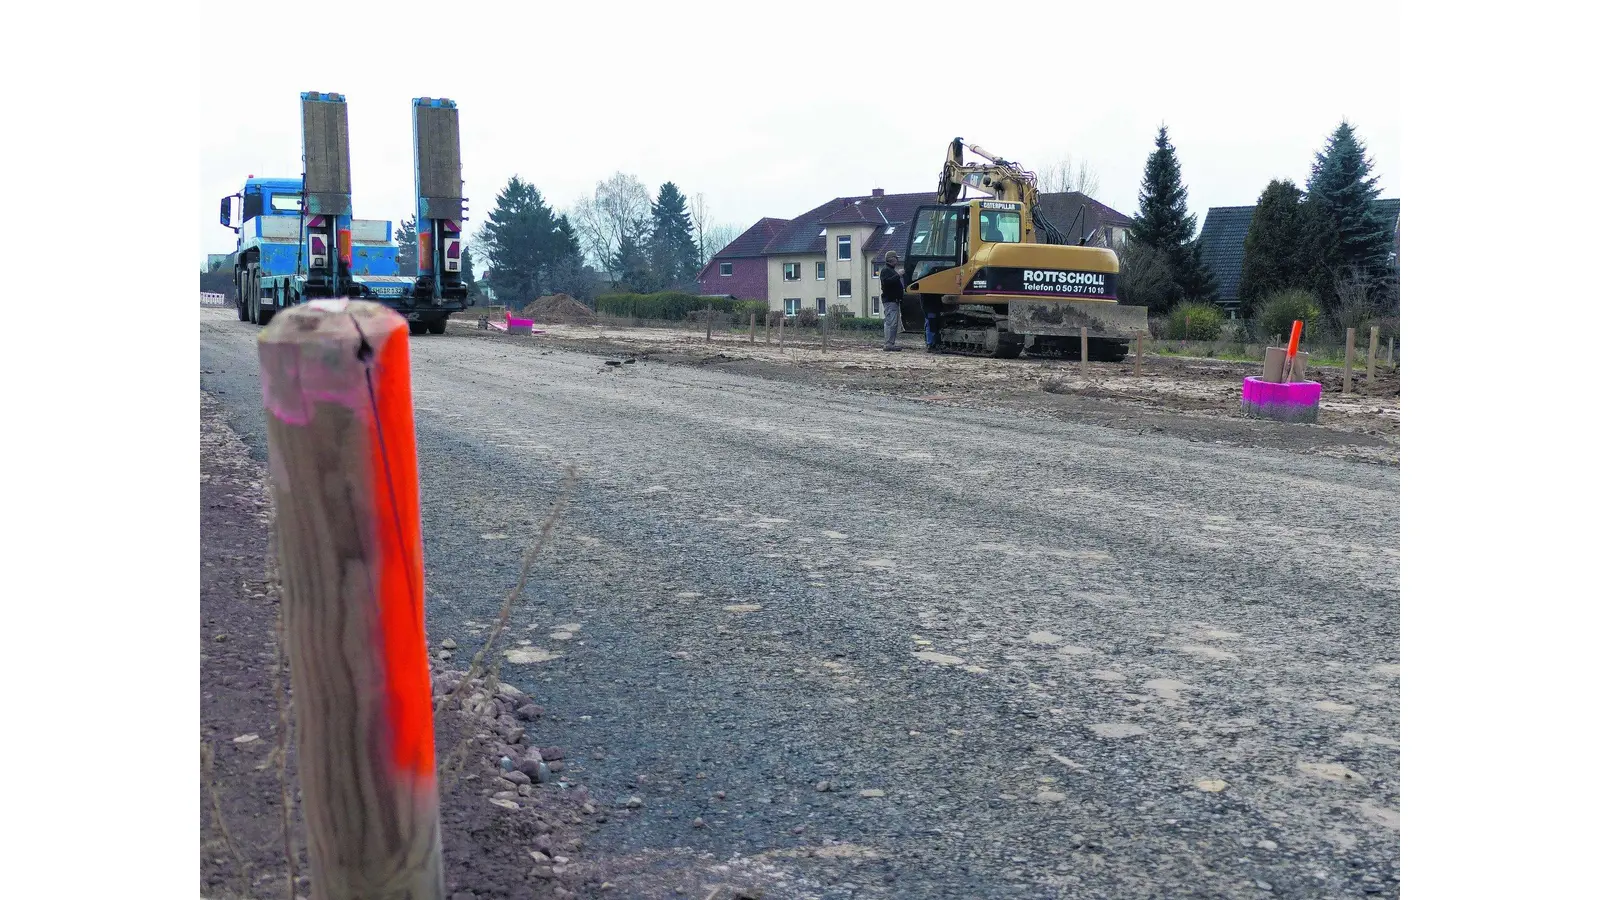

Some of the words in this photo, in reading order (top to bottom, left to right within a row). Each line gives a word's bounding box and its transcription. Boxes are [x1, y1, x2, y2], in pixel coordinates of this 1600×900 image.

[983, 202, 1016, 210] CATERPILLAR
[1023, 270, 1104, 285] ROTTSCHOLL
[1023, 283, 1053, 291] Telefon
[1055, 284, 1061, 292] 0
[1062, 284, 1072, 292] 50
[1073, 285, 1082, 293] 37
[1088, 286, 1097, 294] 10
